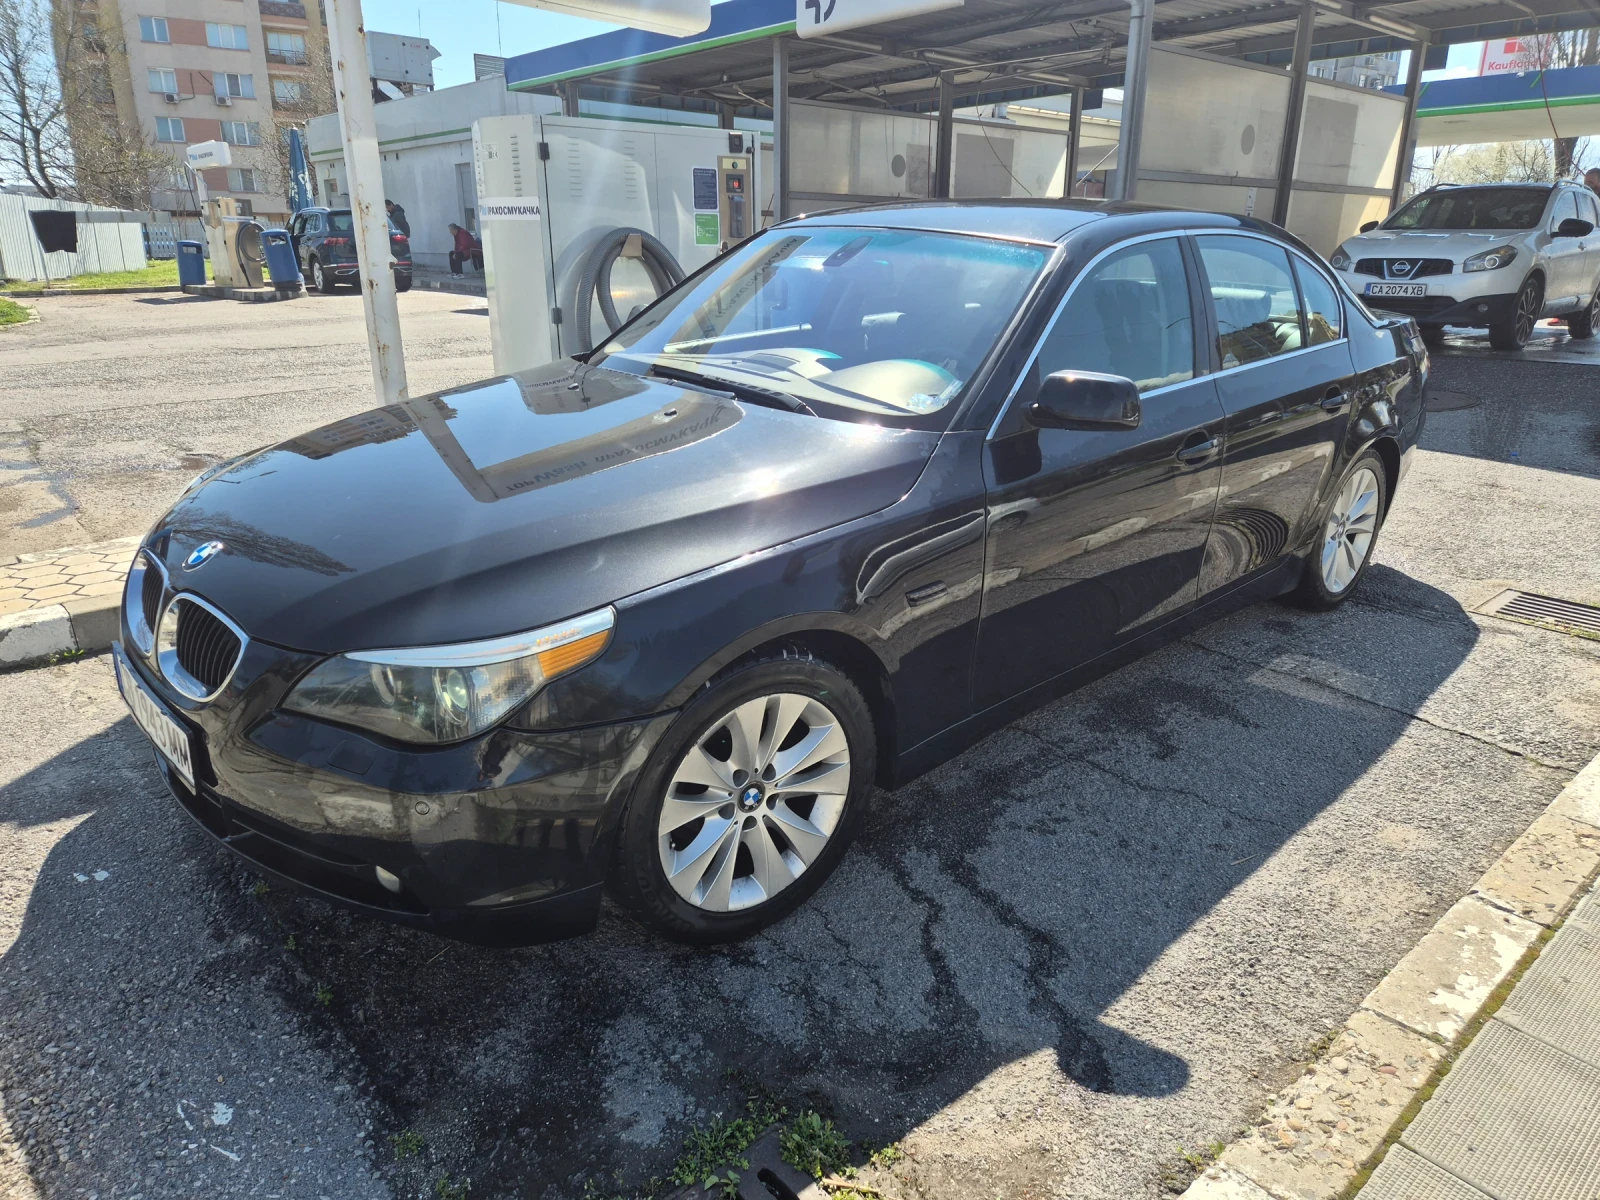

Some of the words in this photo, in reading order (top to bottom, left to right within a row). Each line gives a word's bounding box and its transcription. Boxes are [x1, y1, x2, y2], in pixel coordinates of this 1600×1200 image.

[1371, 285, 1383, 295] CA
[1385, 285, 1409, 295] 2074
[1410, 286, 1423, 296] XB
